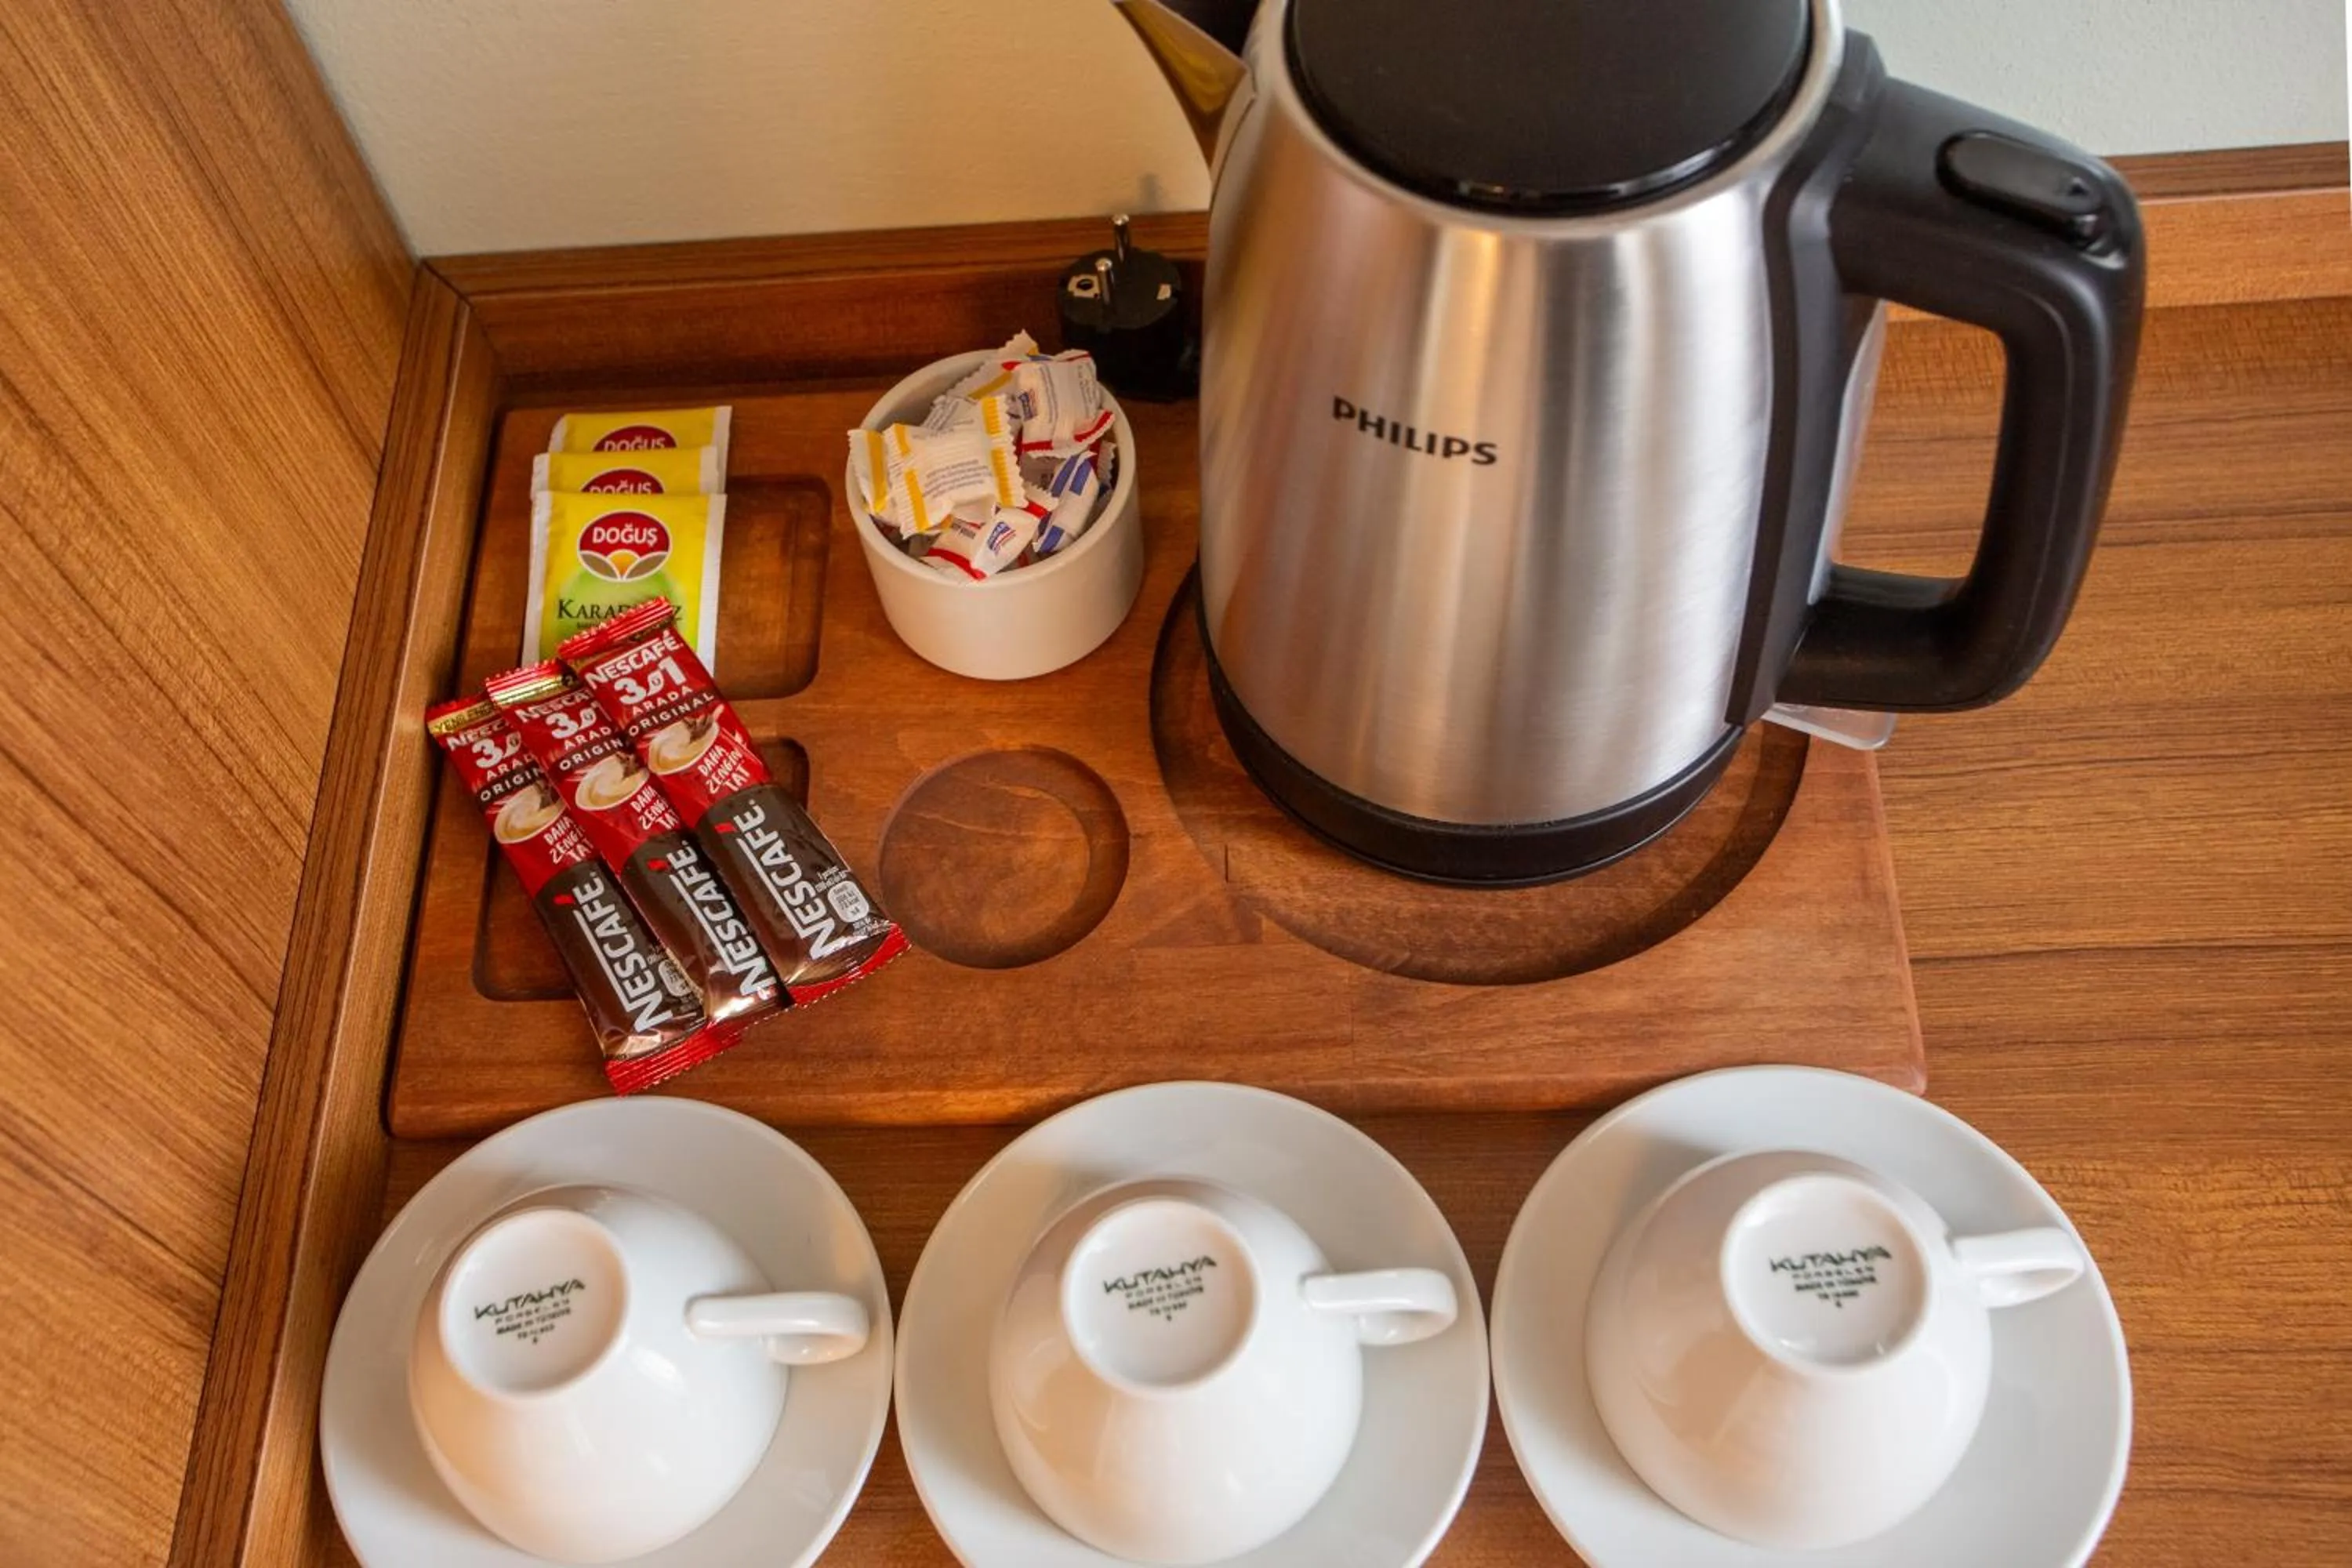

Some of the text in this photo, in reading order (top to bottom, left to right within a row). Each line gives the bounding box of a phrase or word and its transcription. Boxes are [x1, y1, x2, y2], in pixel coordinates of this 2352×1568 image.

[1333, 395, 1497, 465] PHILIPS
[593, 522, 658, 546] DOĞUŞ
[585, 630, 681, 689] NESCAFÉ
[629, 692, 714, 736] ORIGINAL
[632, 684, 693, 716] ARADA
[559, 738, 623, 771] ORIGIN
[564, 726, 612, 750] ARAD
[723, 758, 750, 791] TAT
